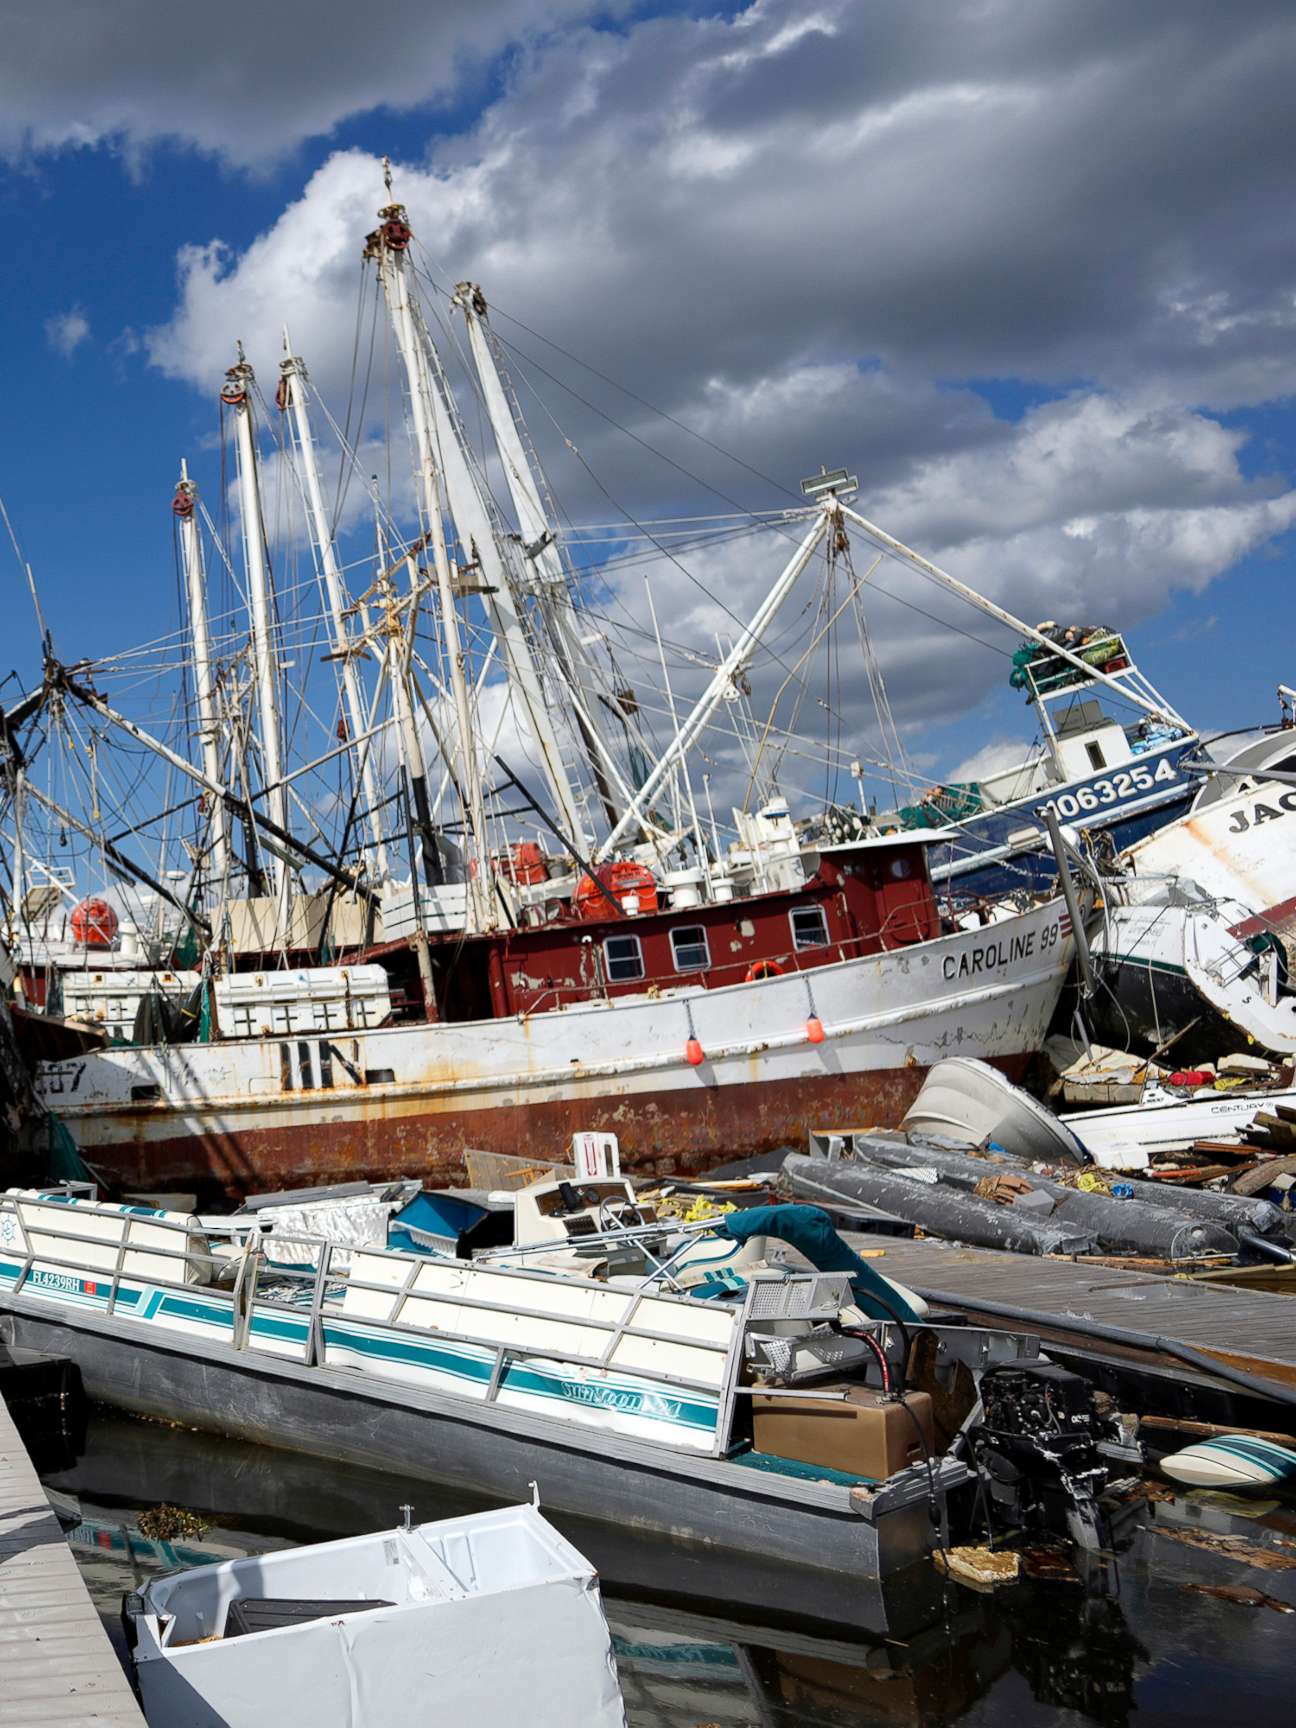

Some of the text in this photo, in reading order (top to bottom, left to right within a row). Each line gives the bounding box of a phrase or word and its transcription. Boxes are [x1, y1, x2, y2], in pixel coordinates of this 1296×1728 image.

[1047, 758, 1177, 821] 1063254
[942, 922, 1059, 980] CAROLINE 99
